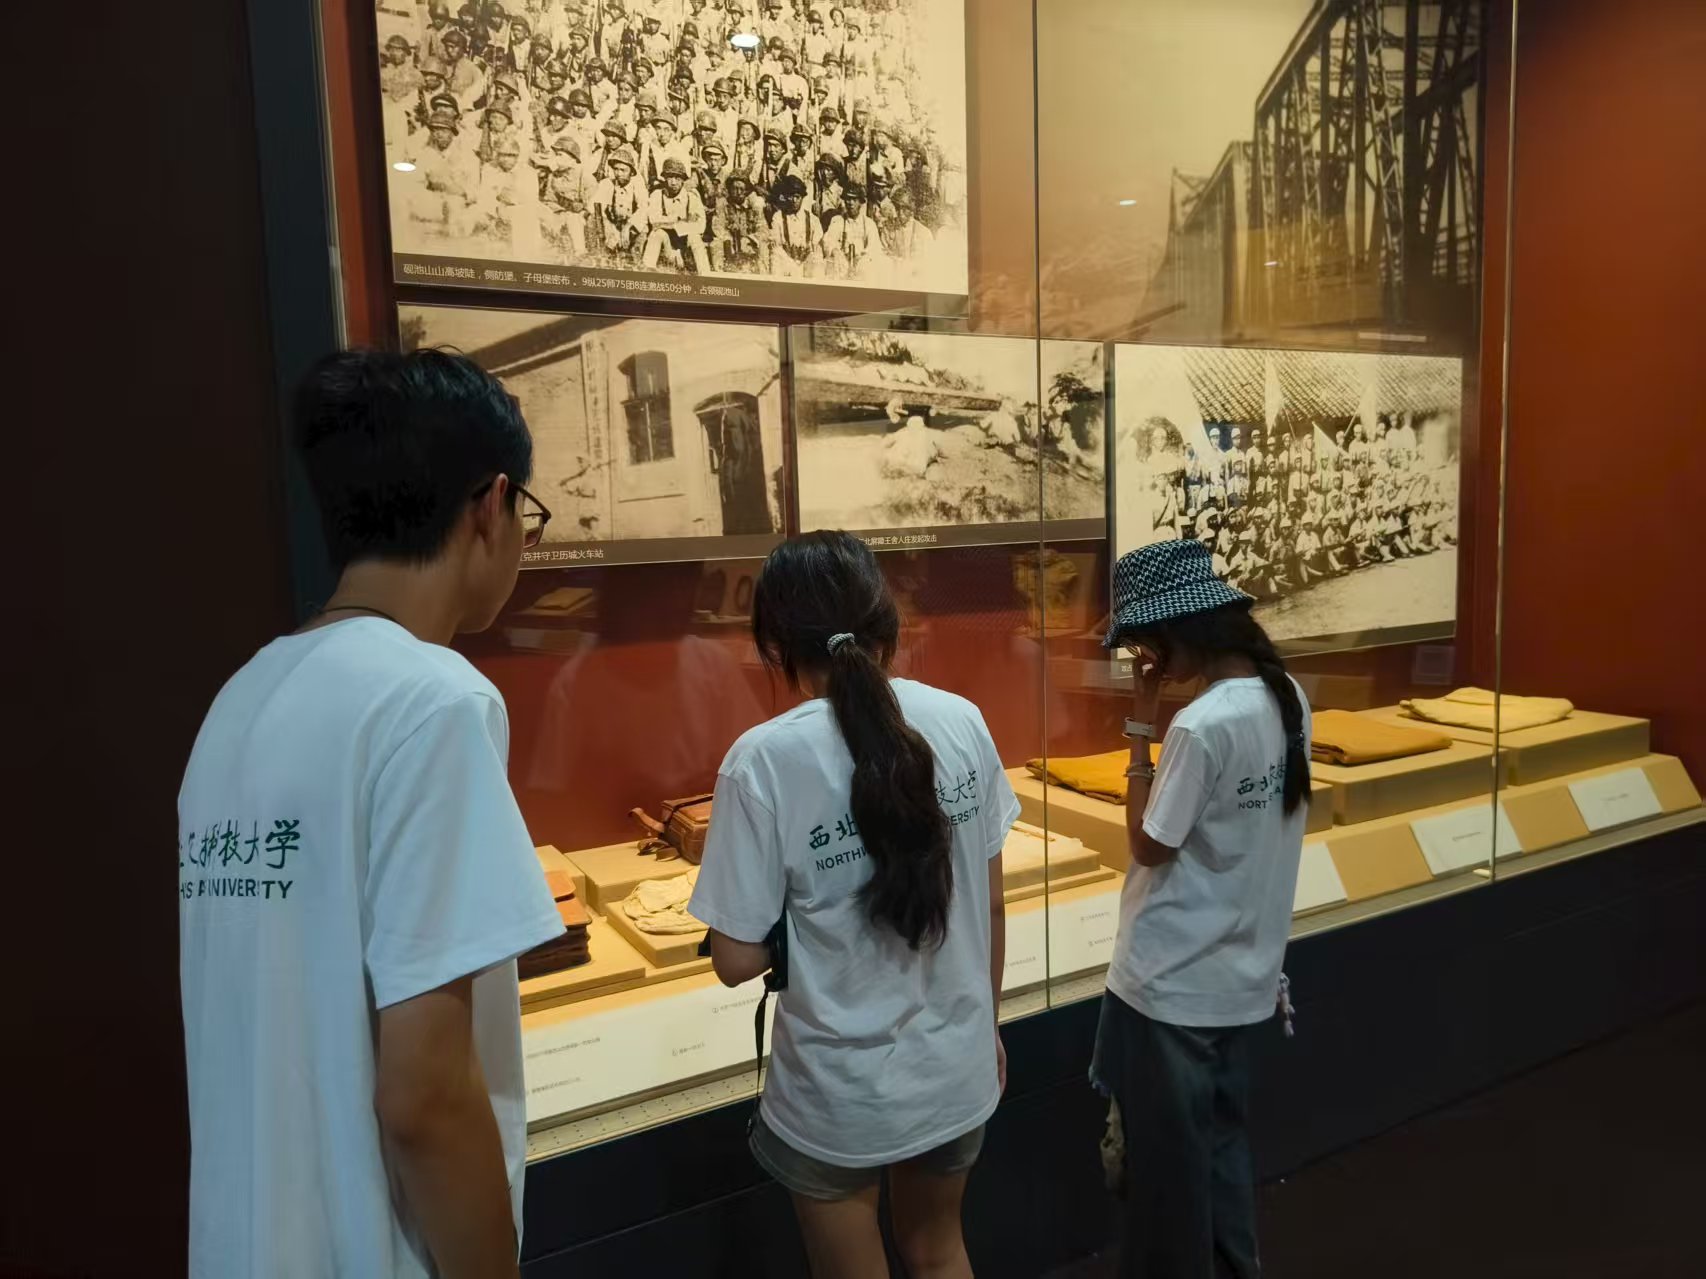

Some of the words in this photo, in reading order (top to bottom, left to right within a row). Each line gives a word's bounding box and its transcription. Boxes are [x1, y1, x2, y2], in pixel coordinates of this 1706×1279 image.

[859, 534, 937, 547] 北屏障王舍人庄发起攻击
[950, 805, 980, 826] ERSITY
